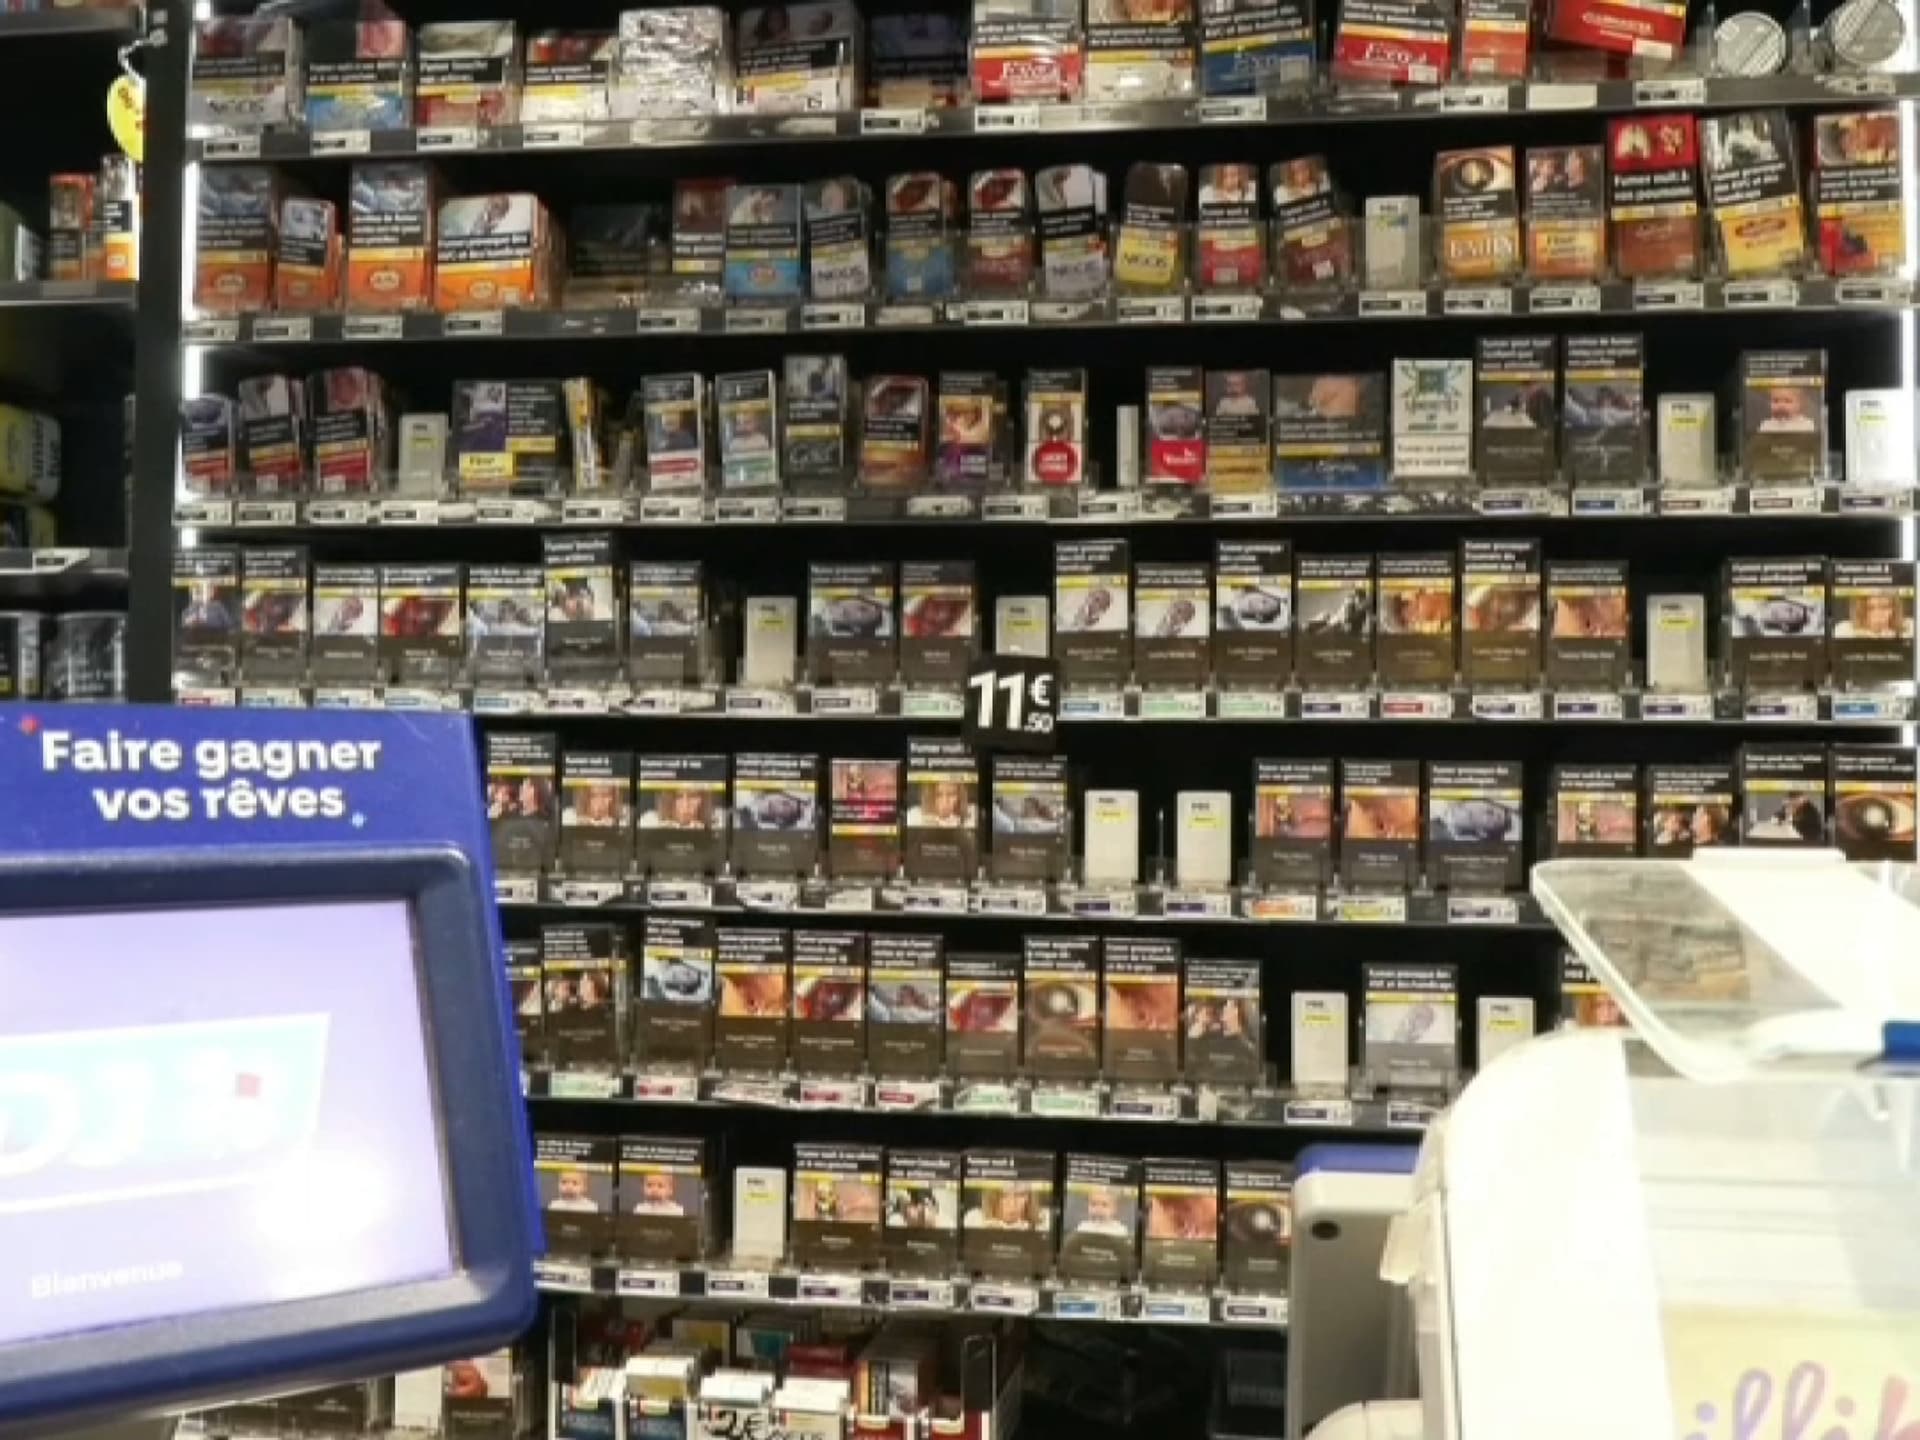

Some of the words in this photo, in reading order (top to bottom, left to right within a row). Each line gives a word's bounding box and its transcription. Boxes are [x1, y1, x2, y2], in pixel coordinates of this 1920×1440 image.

[41, 729, 183, 772] Faire
[194, 738, 382, 780] gagner
[92, 787, 192, 821] vos
[200, 777, 347, 819] rêves
[31, 1257, 185, 1301] Bienvenue
